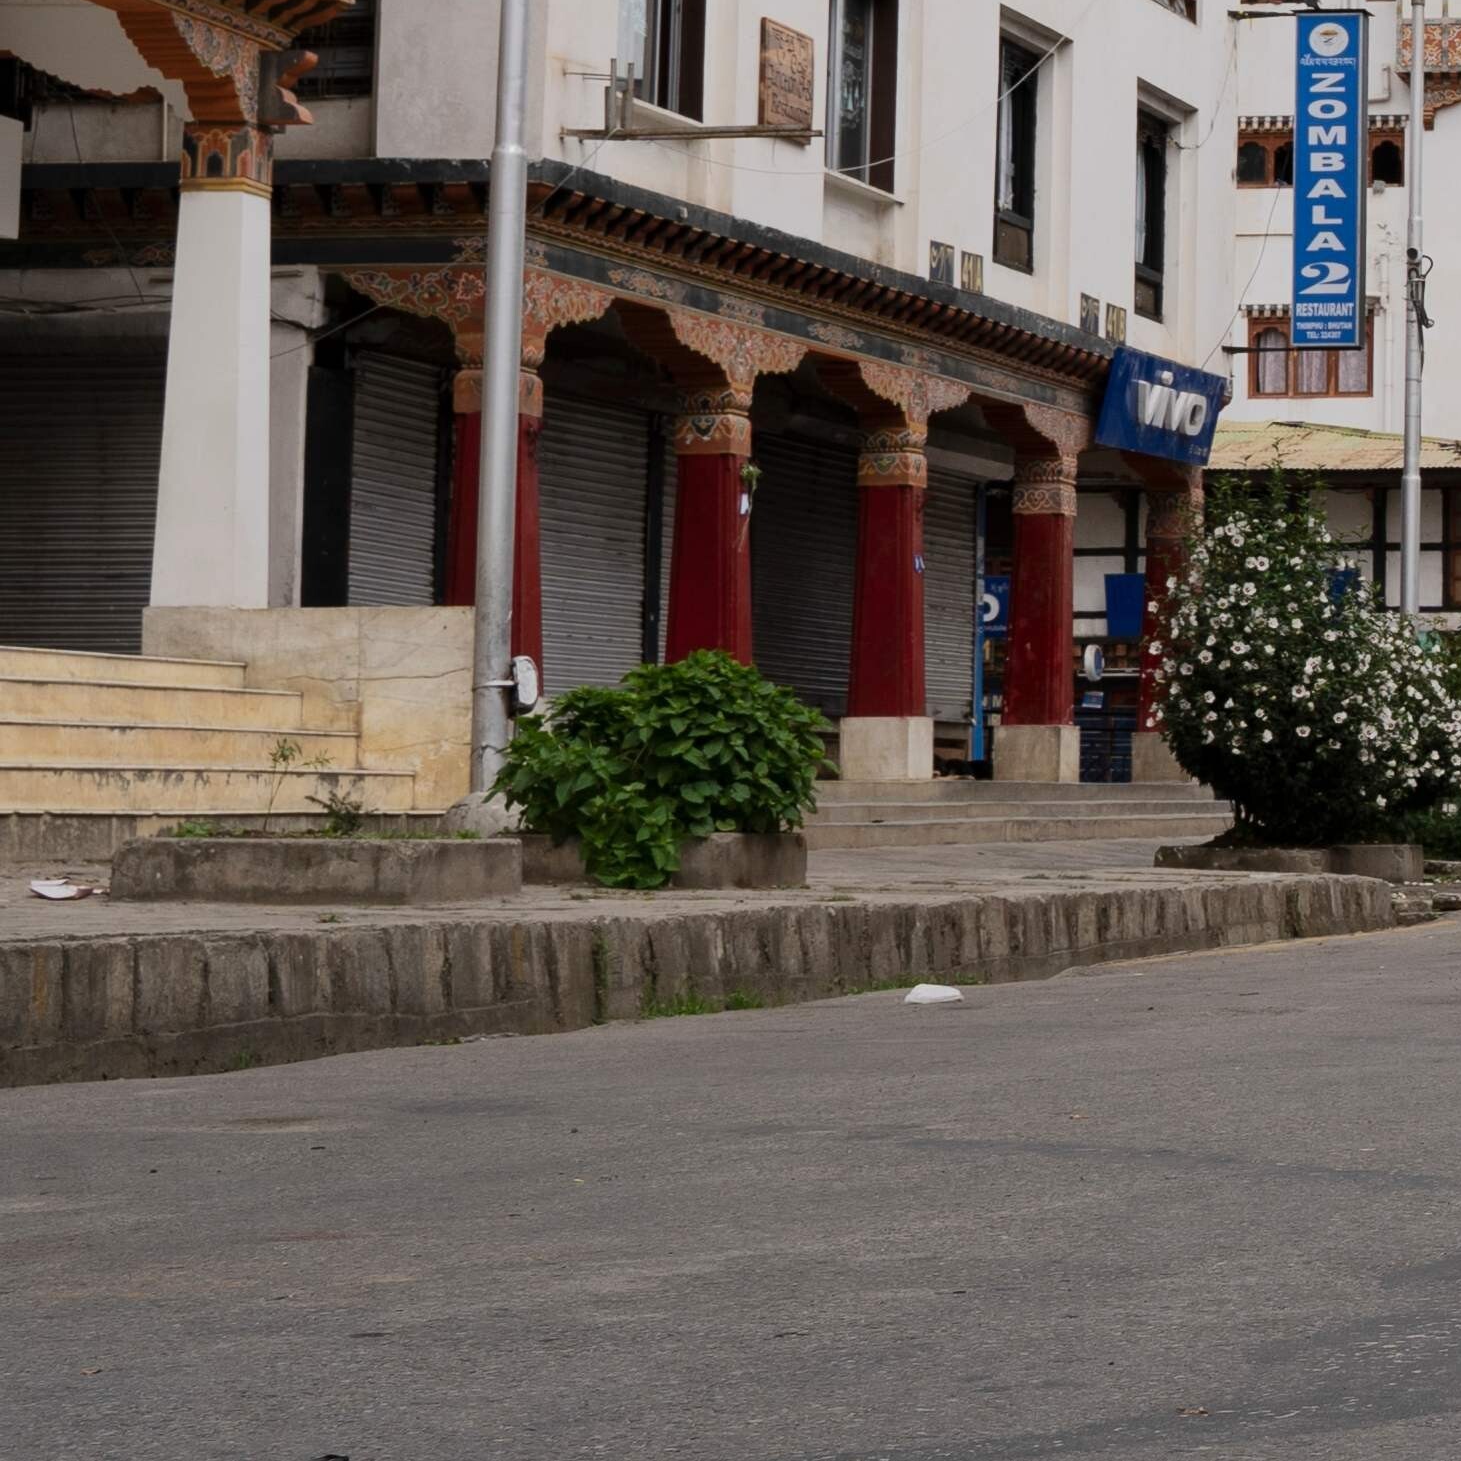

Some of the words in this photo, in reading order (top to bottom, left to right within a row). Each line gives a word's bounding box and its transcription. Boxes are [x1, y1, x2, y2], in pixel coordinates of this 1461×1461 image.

[1305, 72, 1348, 252] ZOMBALA
[1298, 261, 1352, 295] 2
[1296, 303, 1354, 317] RESTAURANT
